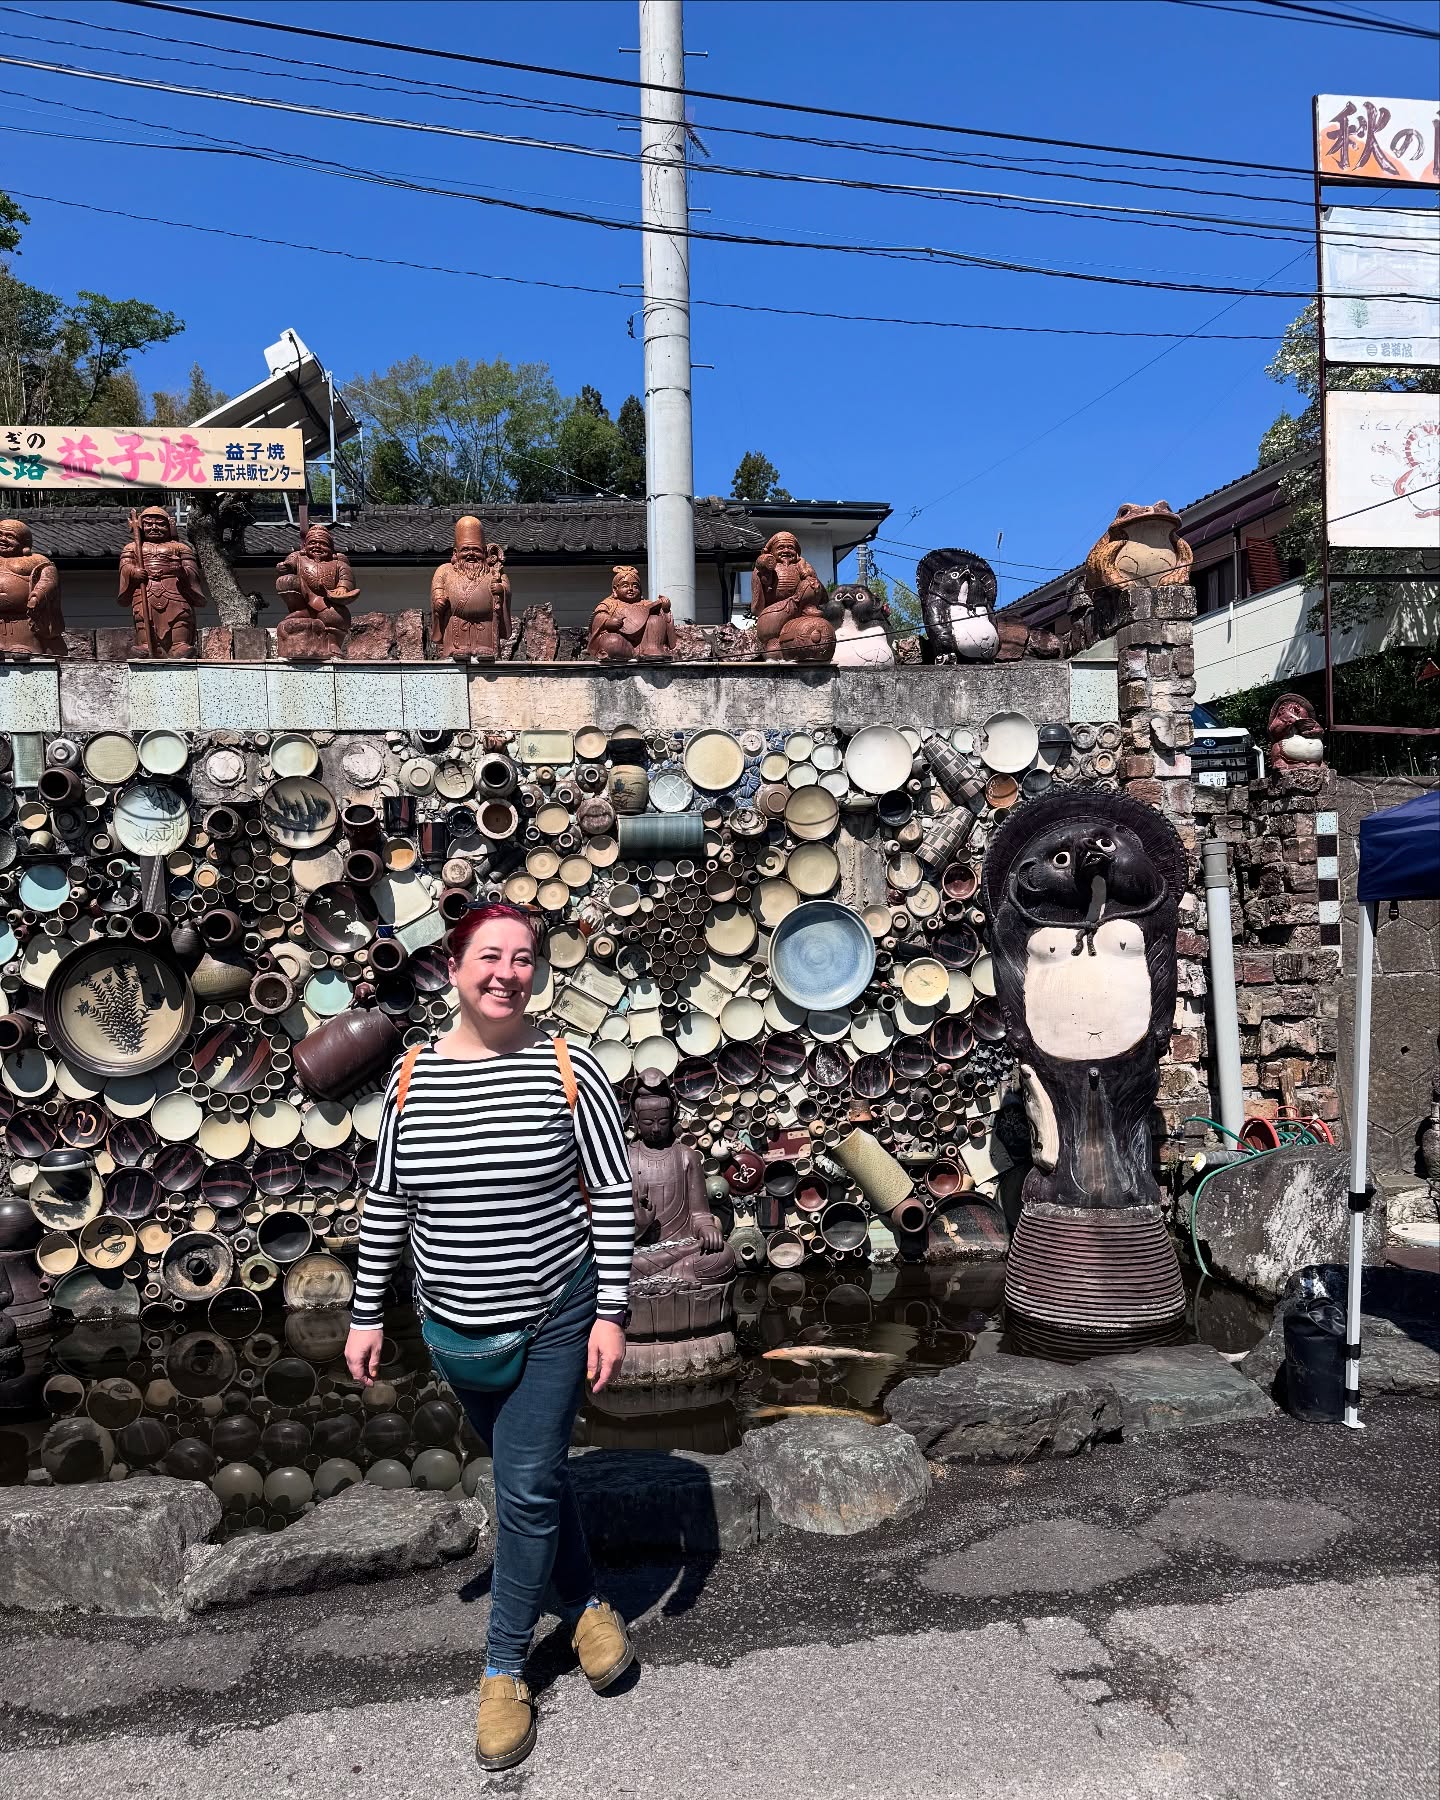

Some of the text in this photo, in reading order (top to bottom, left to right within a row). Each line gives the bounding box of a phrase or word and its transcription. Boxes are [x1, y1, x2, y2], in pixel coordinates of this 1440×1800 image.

[1325, 101, 1439, 176] 秋の
[57, 434, 207, 483] 益子焼
[225, 442, 286, 461] 益子焼
[212, 464, 301, 482] 窯元共販センター
